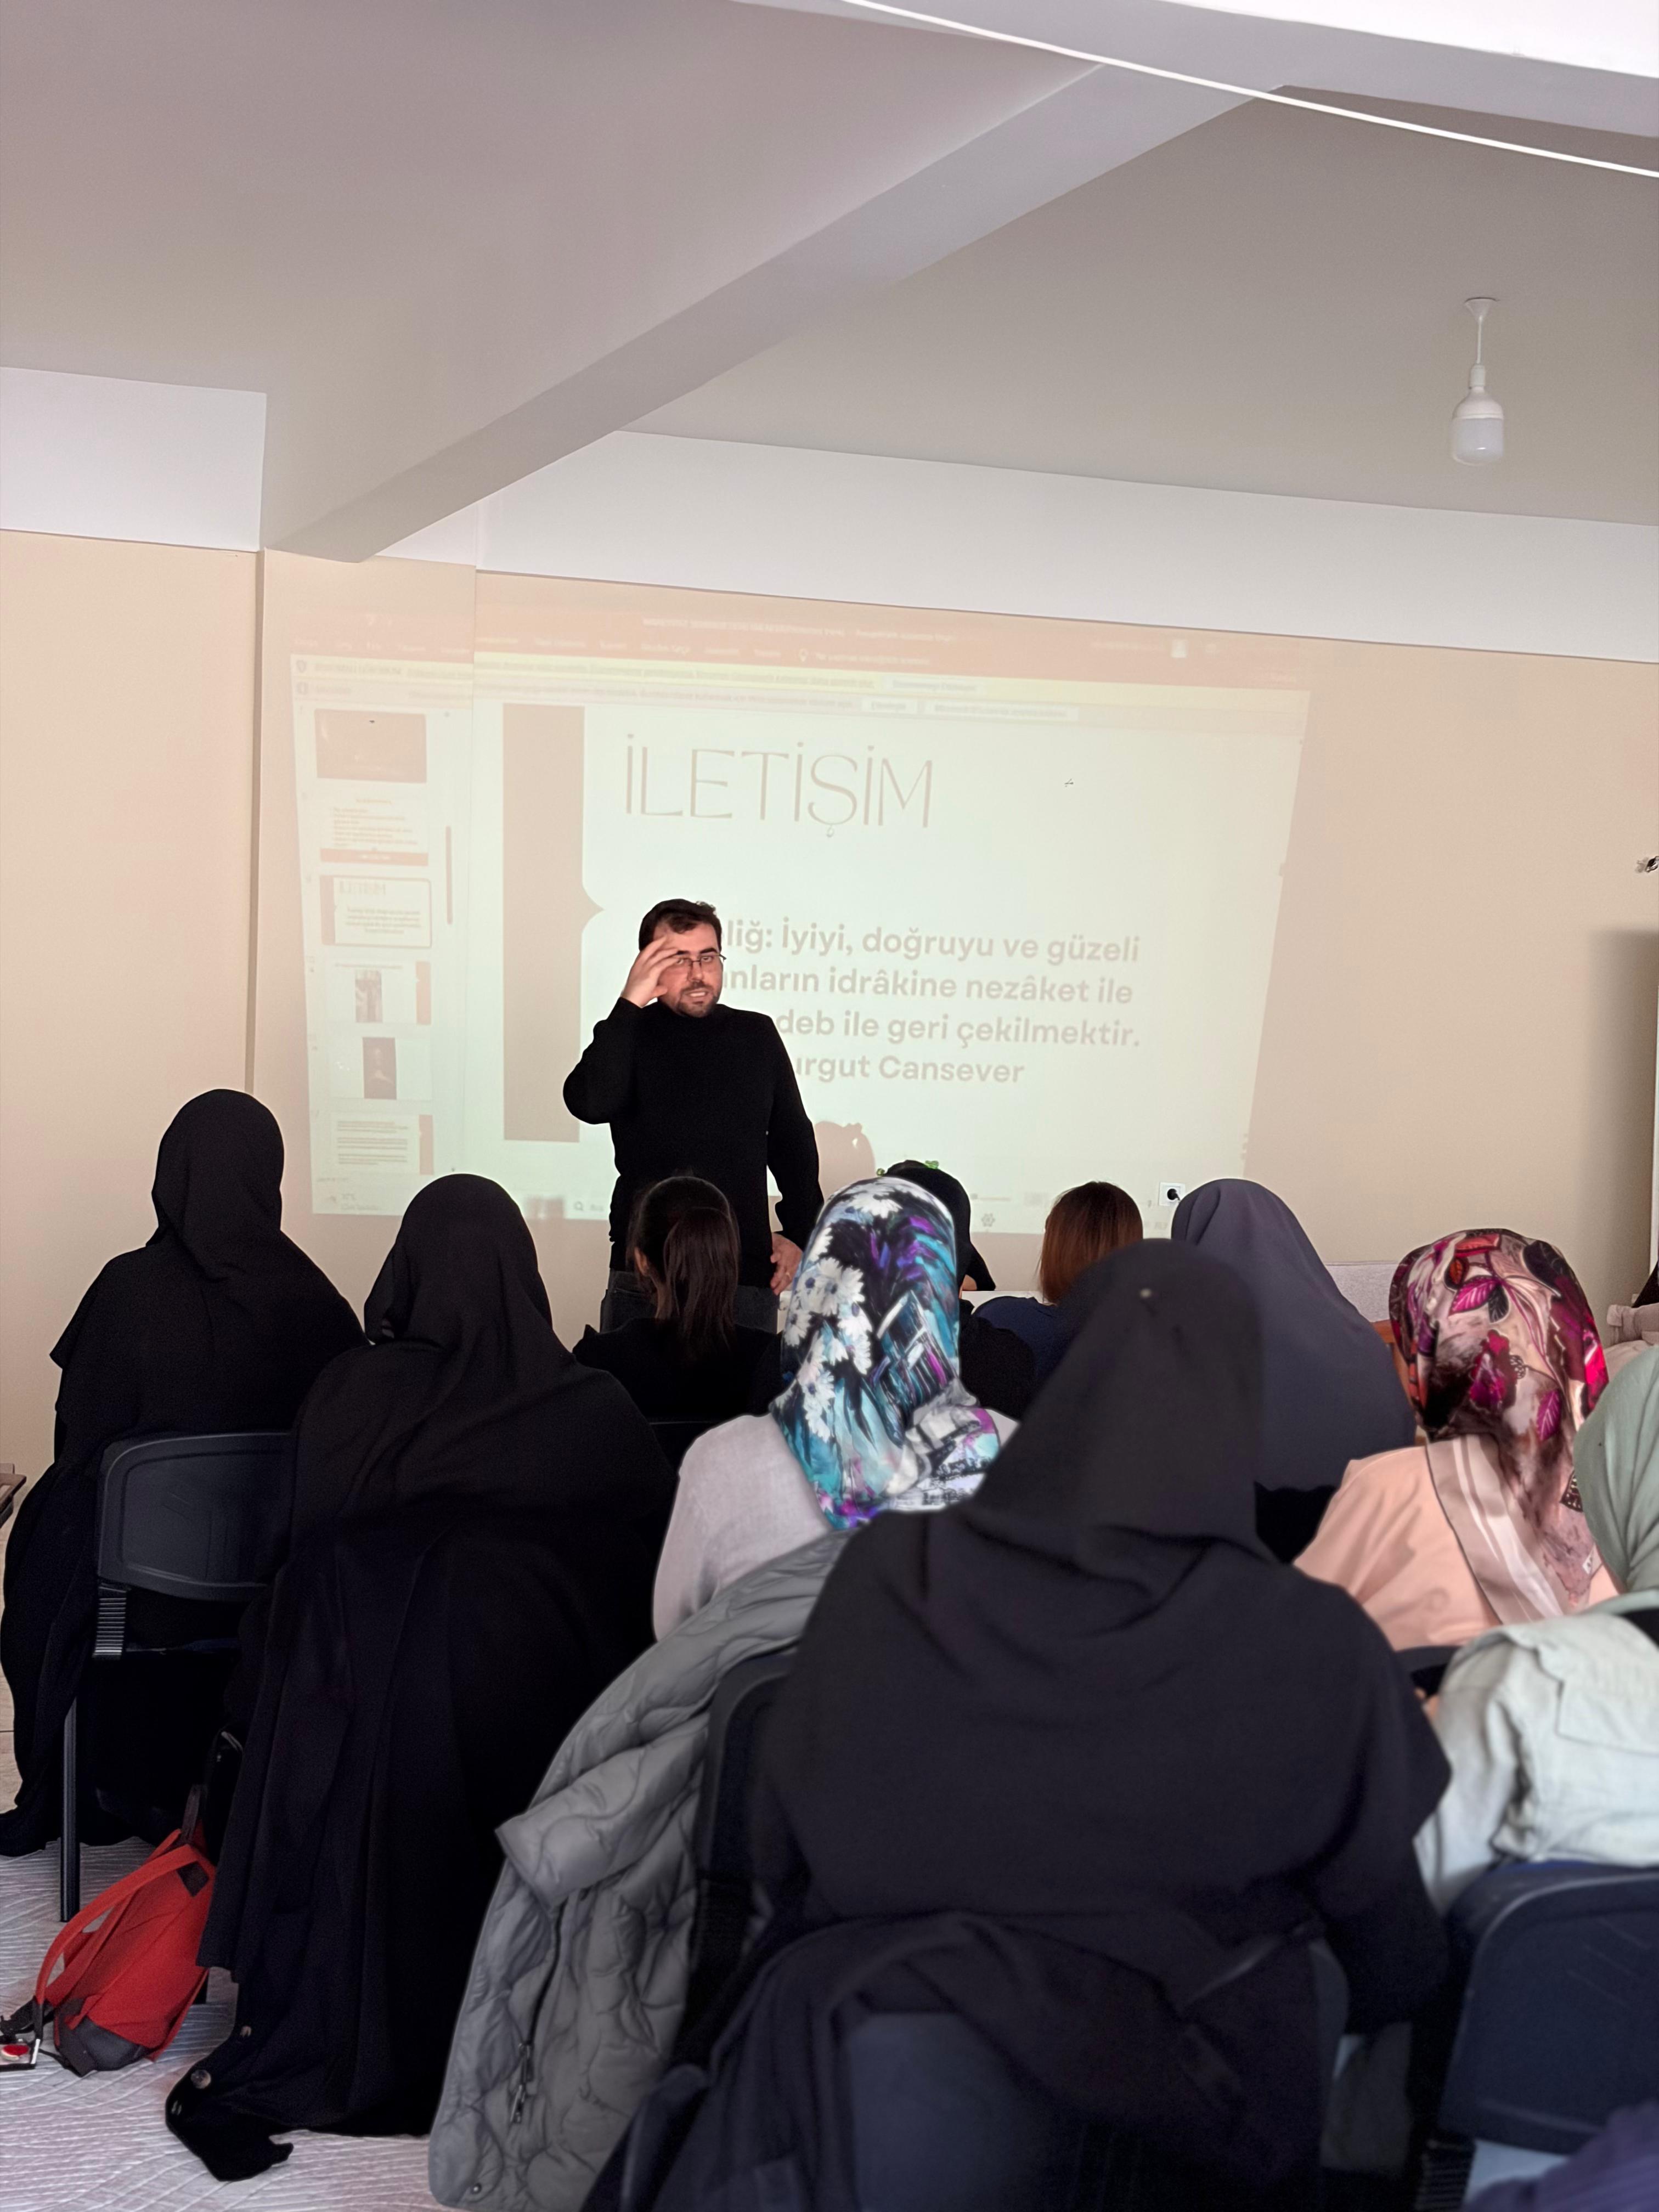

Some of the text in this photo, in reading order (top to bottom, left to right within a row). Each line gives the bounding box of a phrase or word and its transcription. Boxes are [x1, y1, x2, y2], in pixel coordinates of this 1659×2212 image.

[626, 733, 932, 837] İLETİŞİM
[727, 917, 1139, 966] liğ: İyiyi, doğruyu ve güzeli
[724, 964, 1133, 1004] nların idrâkine nezâket ile
[776, 1008, 1139, 1049] deb ile geri çekilmektir.
[796, 1055, 1025, 1083] rgut Cansever
